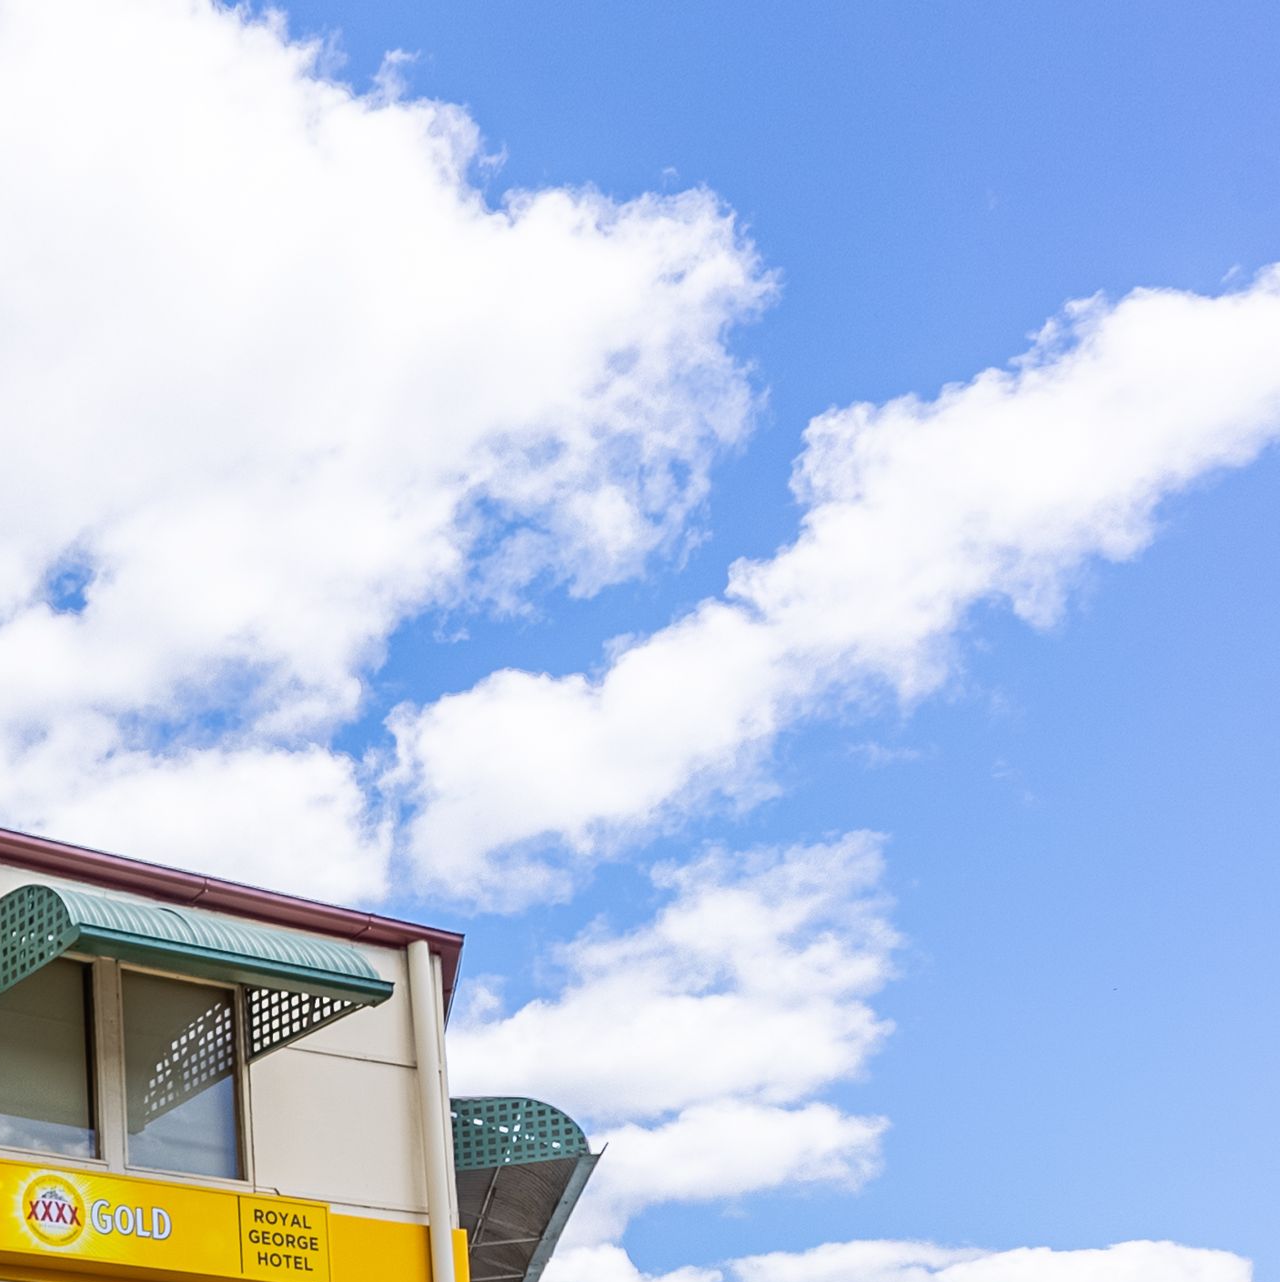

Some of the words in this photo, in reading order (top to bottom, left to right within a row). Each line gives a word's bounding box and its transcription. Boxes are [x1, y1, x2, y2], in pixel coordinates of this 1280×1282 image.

[27, 1200, 81, 1227] XXXX
[91, 1199, 172, 1240] GOLD
[254, 1208, 312, 1229] ROYAL
[248, 1229, 319, 1251] GEORGE
[257, 1251, 313, 1271] HOTEL
